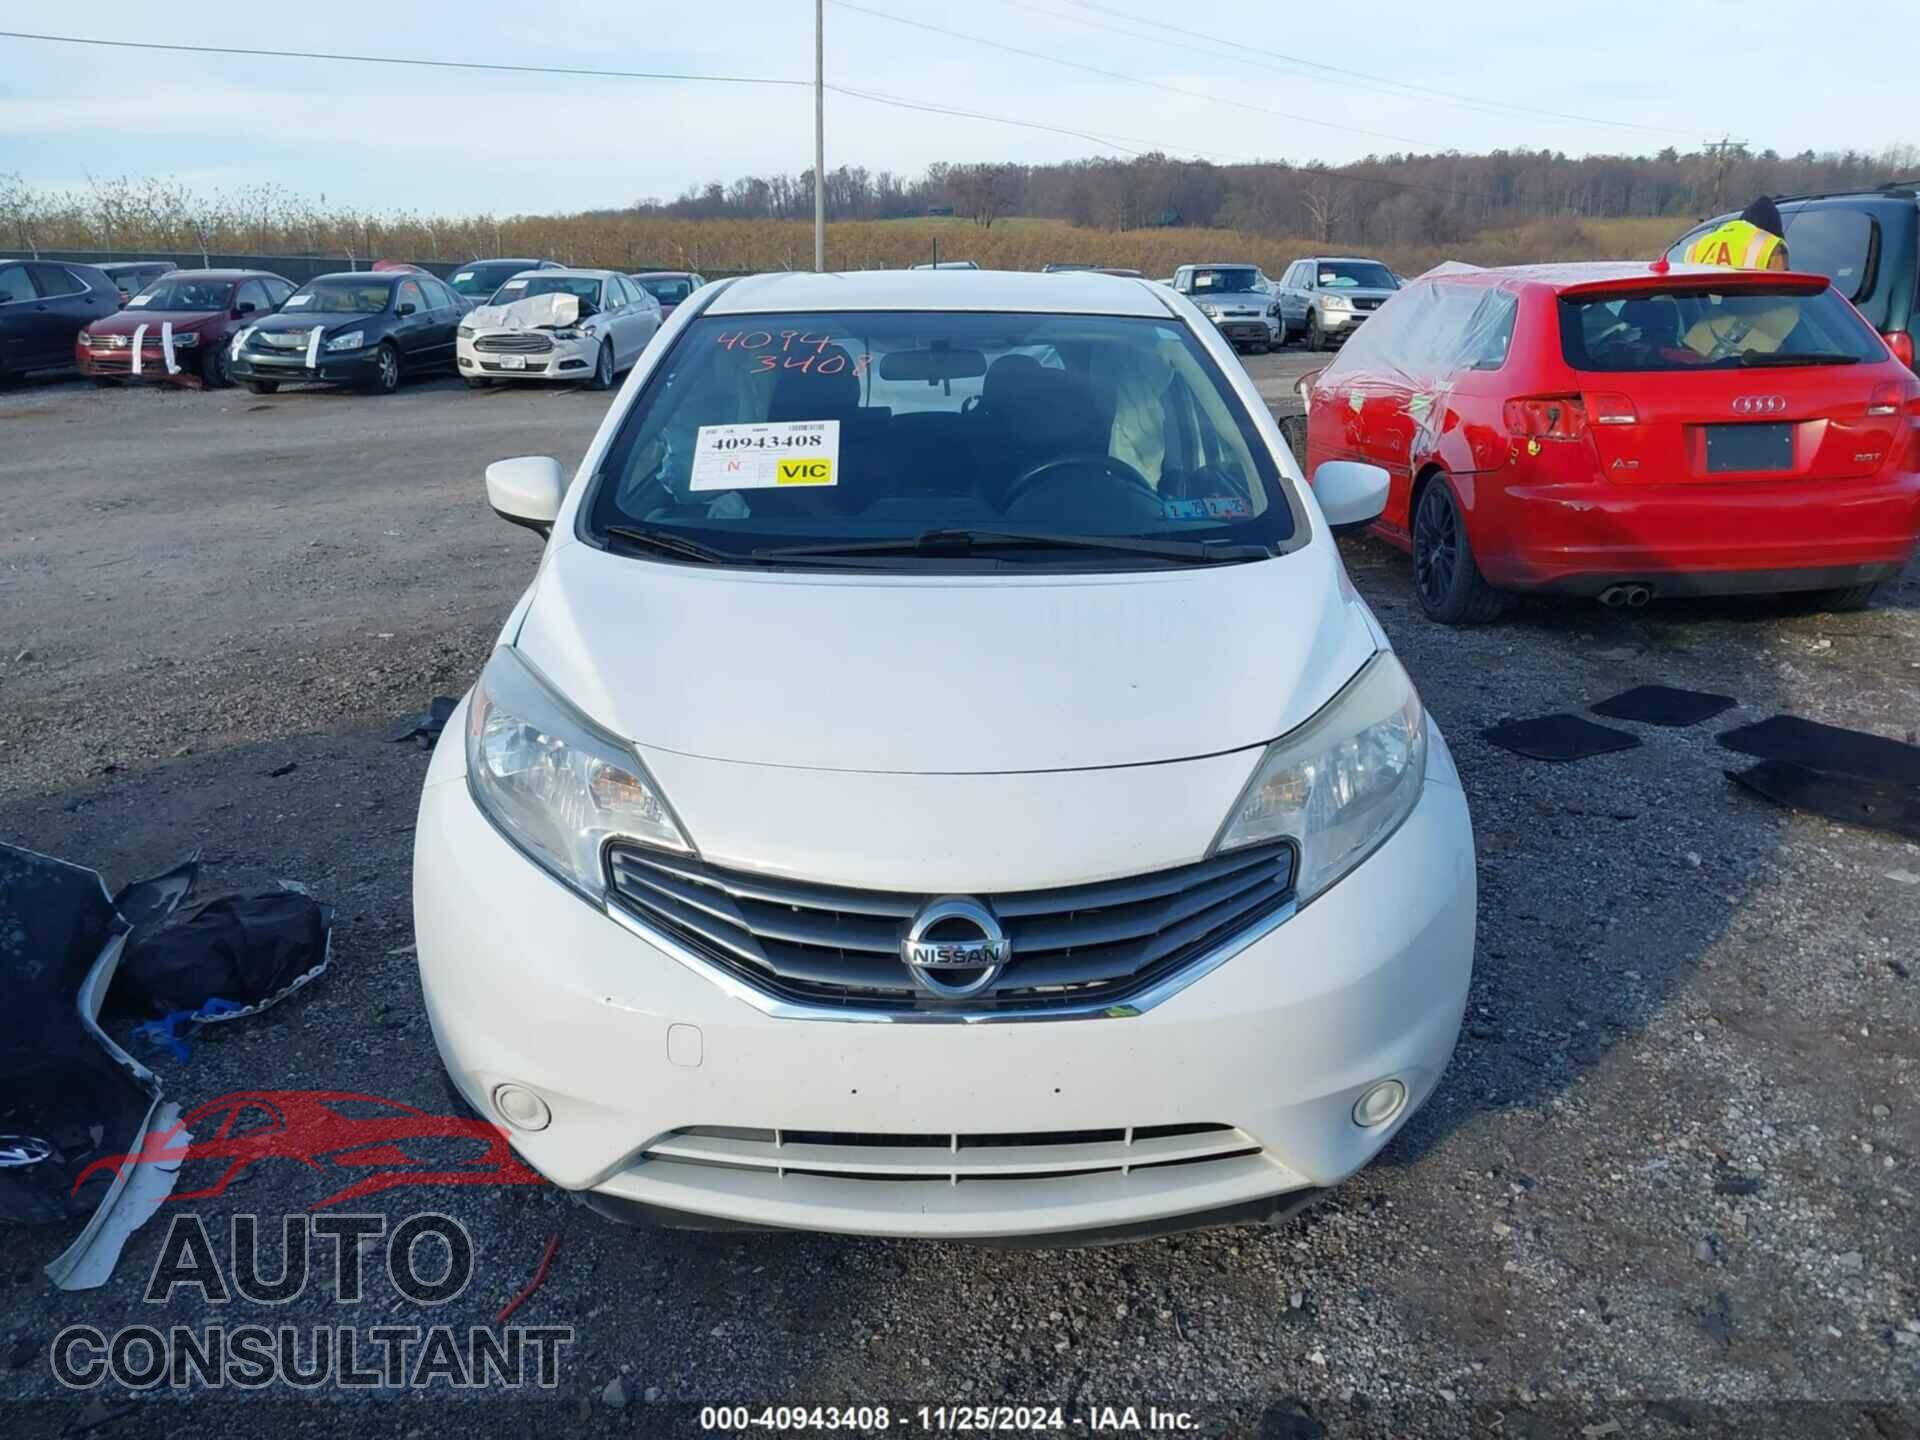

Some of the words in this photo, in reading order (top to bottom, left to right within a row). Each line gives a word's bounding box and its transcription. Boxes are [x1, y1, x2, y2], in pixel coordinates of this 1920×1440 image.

[717, 330, 833, 353] 4094
[750, 354, 874, 377] 3408
[711, 434, 823, 451] 40943408
[782, 463, 828, 479] VIC
[912, 946, 1000, 963] NISSAN
